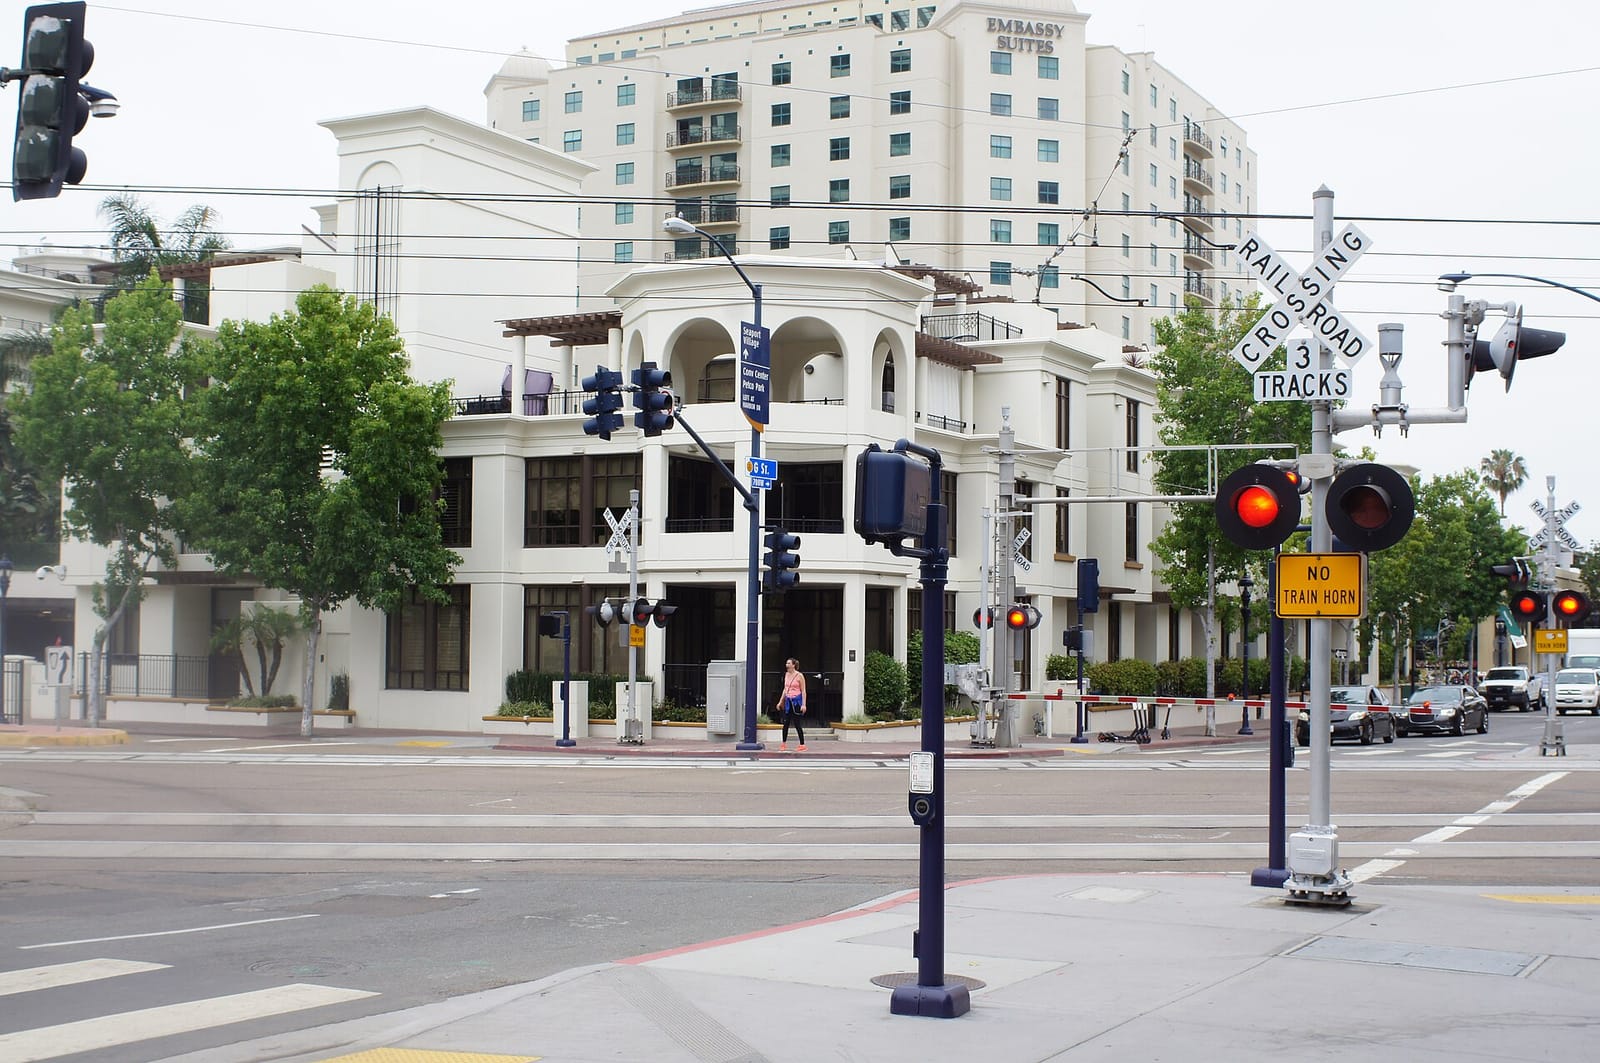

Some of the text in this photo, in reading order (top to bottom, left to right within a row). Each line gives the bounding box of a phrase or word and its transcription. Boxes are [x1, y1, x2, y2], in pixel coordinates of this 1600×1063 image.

[987, 17, 1065, 39] EMBASSY
[997, 35, 1054, 54] SUITES
[1242, 232, 1362, 363] CROSSING
[743, 326, 761, 339] Seaport
[743, 335, 759, 349] Village
[1295, 345, 1310, 369] 3
[742, 367, 769, 381] Conv Center
[742, 379, 765, 392] Petco Park
[1259, 372, 1348, 398] TRACKS
[754, 461, 759, 474] G
[1307, 566, 1330, 581] NO
[1283, 589, 1355, 604] TRAIN HORN
